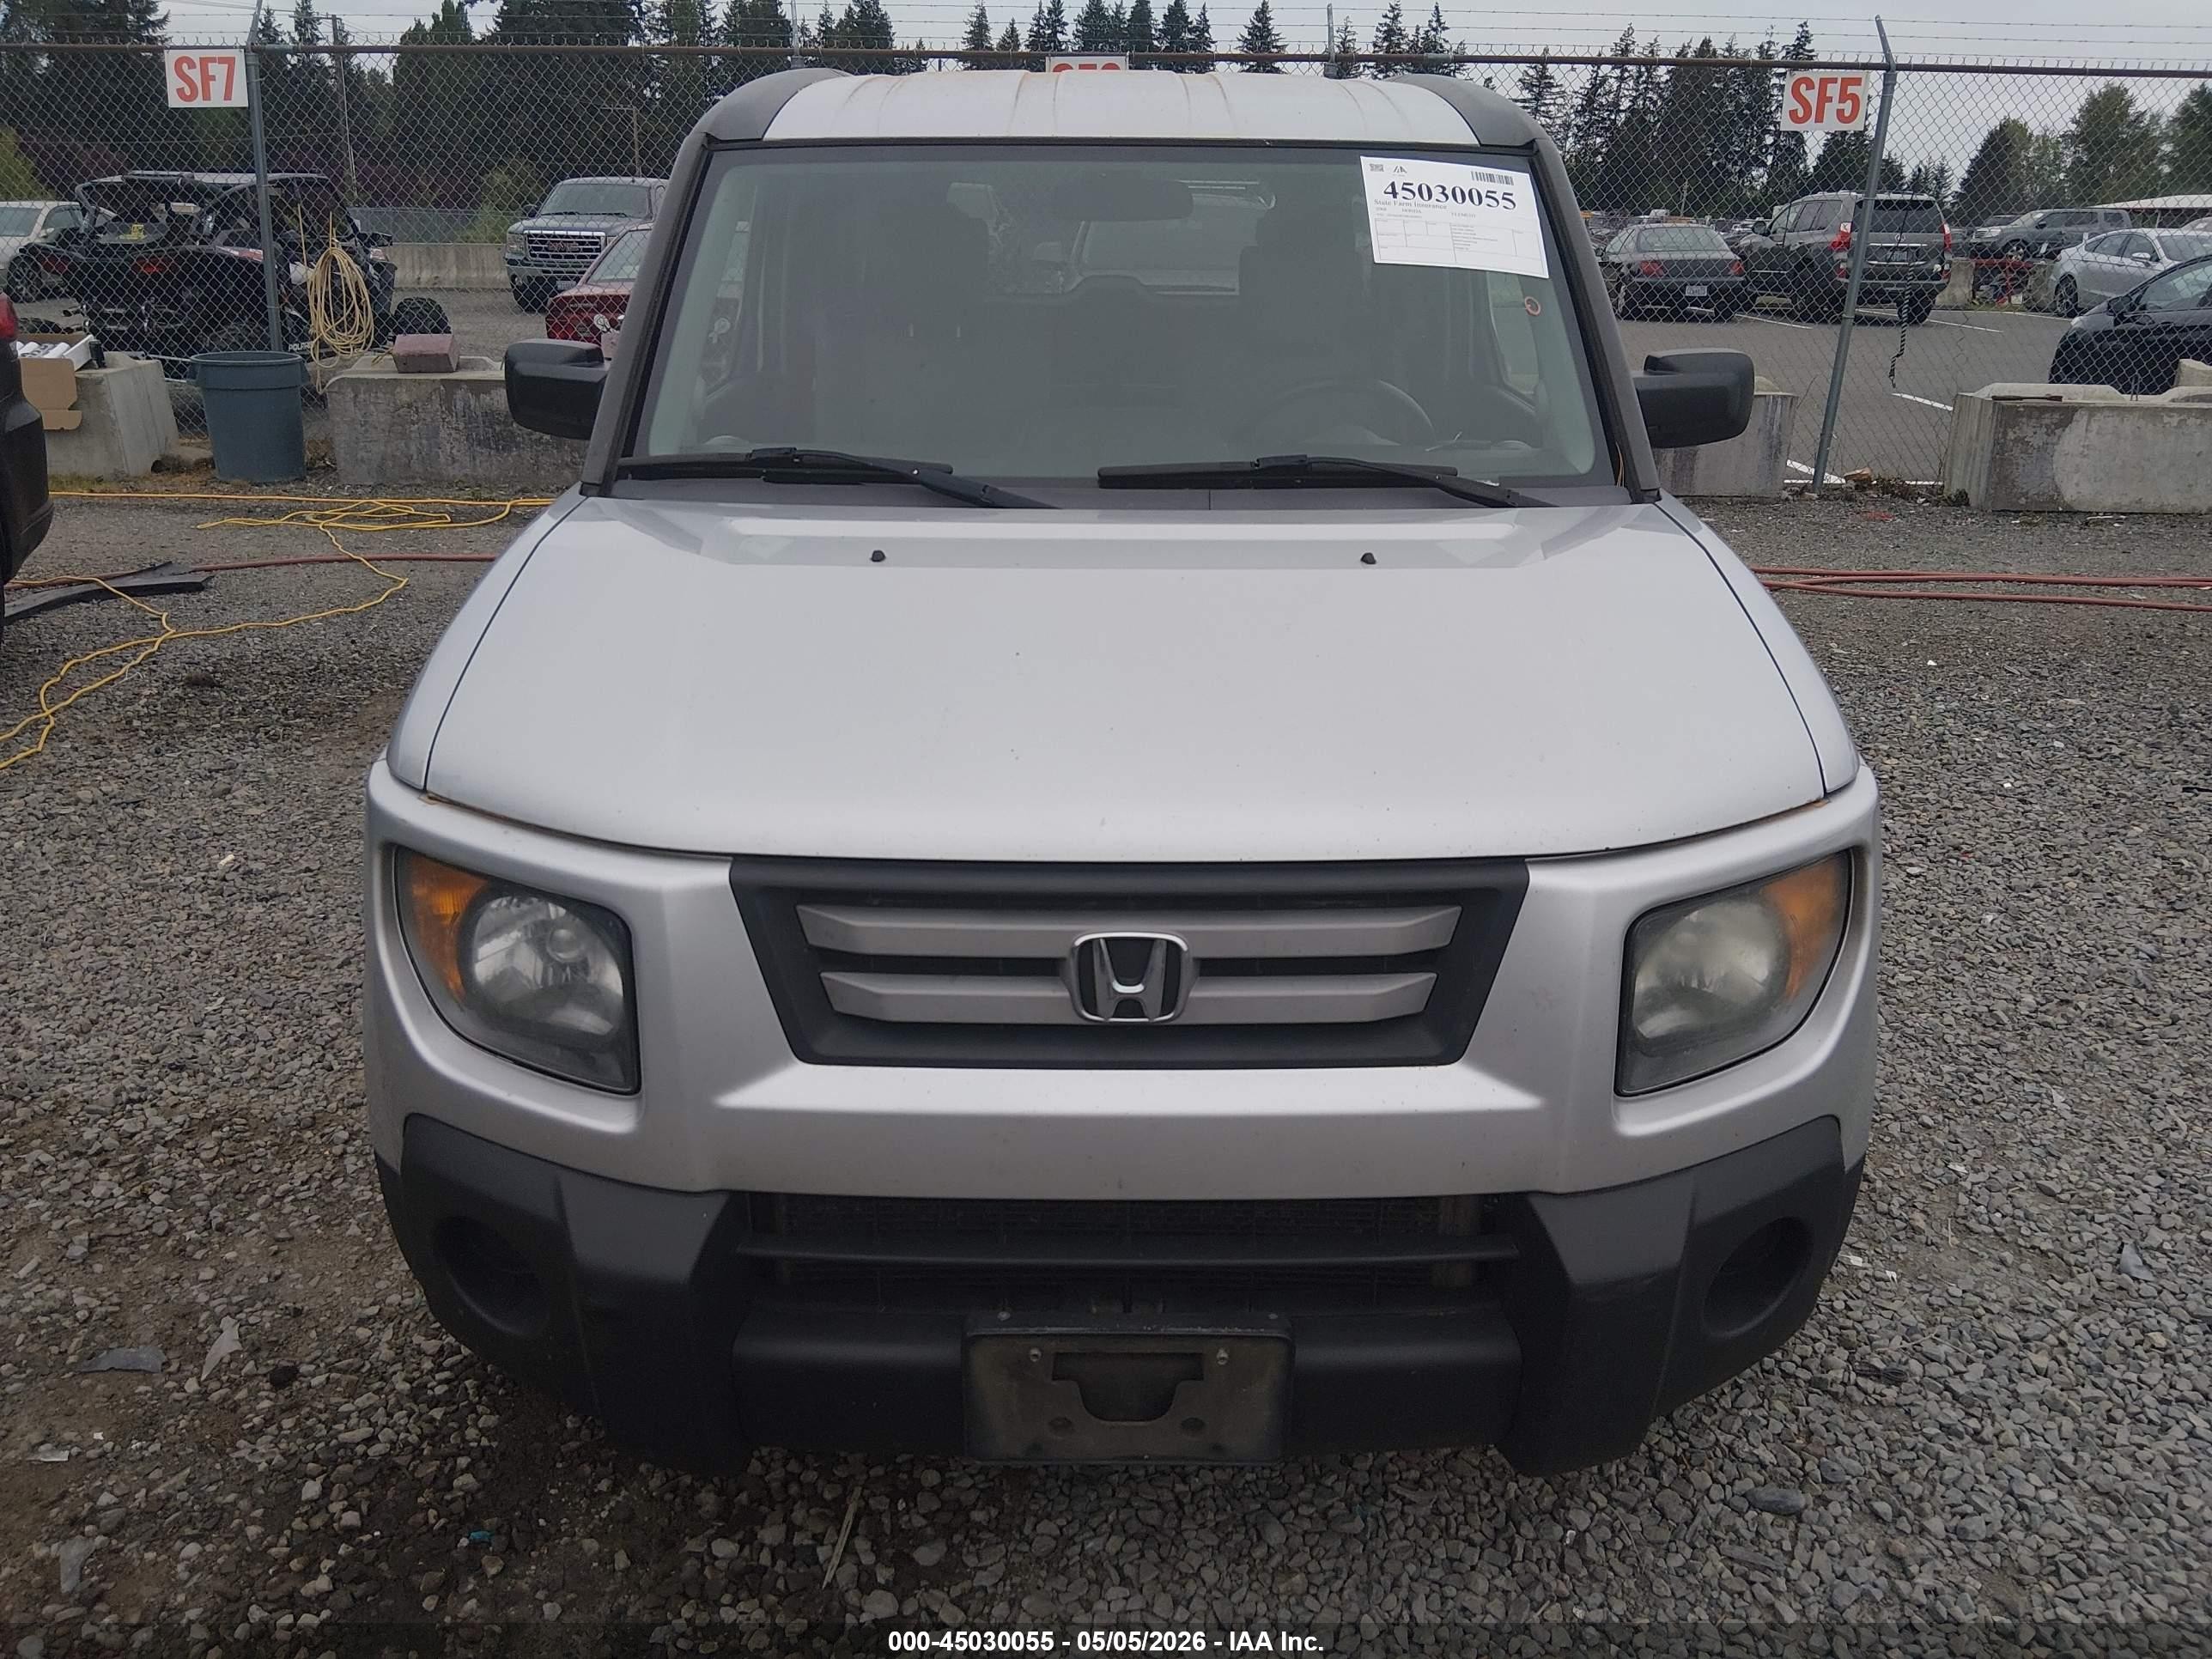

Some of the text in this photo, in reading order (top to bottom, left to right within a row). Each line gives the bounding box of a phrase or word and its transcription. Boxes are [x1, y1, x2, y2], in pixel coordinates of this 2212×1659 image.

[173, 56, 235, 102] SF7
[1789, 76, 1863, 125] SF5
[1383, 180, 1516, 210] 45030055
[289, 342, 312, 352] POLAR
